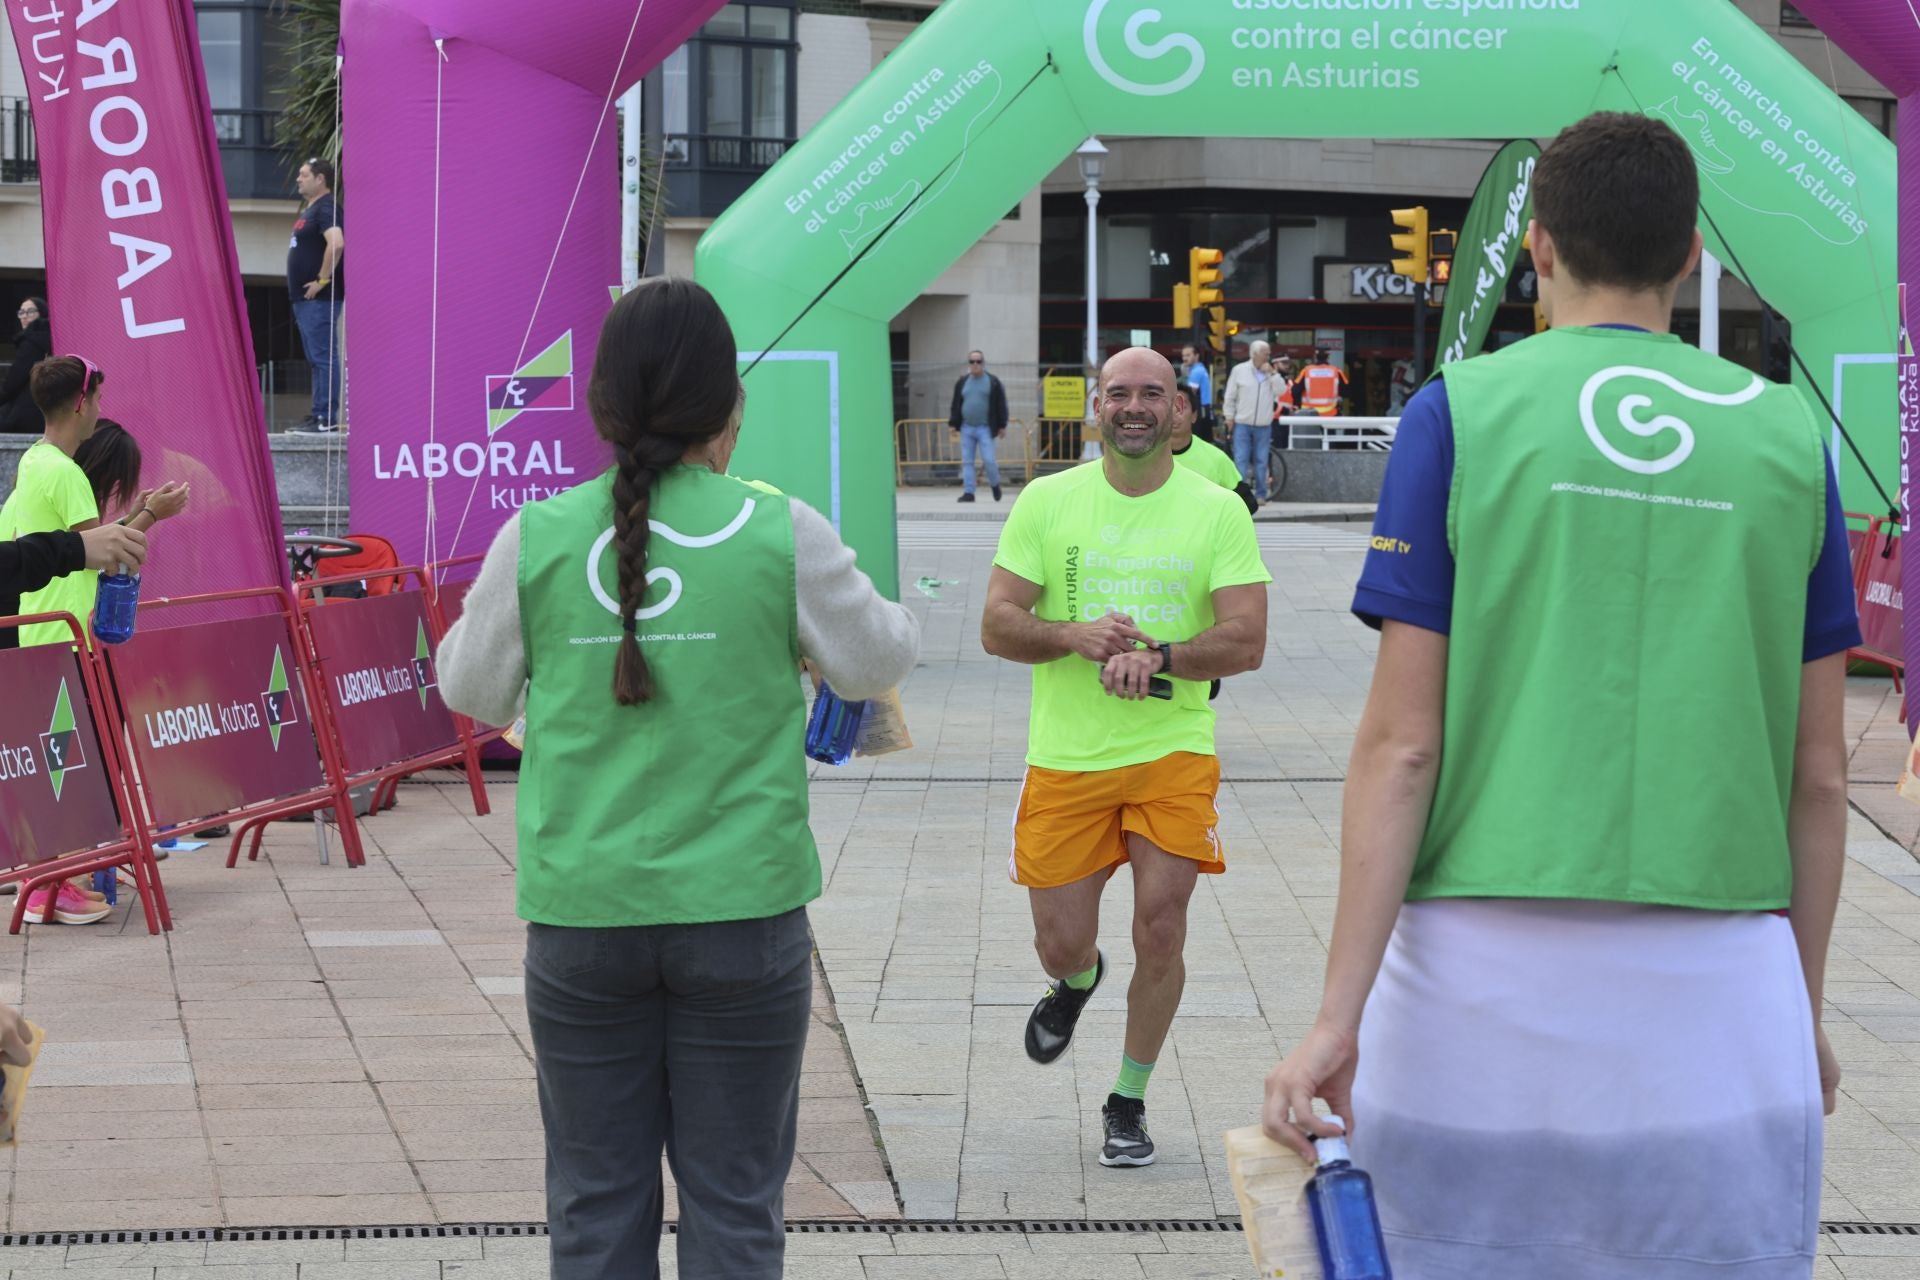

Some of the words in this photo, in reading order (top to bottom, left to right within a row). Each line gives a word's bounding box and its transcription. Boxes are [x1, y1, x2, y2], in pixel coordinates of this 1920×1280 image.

[1231, 21, 1341, 49] contra
[1351, 20, 1379, 50] el
[1389, 21, 1508, 50] cáncer
[1232, 66, 1273, 88] en
[1282, 61, 1420, 88] Asturias
[1691, 36, 1720, 67] En
[1719, 63, 1793, 132] marcha
[1793, 128, 1858, 188] contra
[784, 187, 814, 216] En
[812, 124, 884, 191] marcha
[882, 67, 945, 125] contra
[804, 210, 828, 235] el
[825, 152, 889, 216] cáncer
[889, 129, 917, 156] en
[914, 58, 994, 134] Asturias
[1671, 61, 1698, 84] el
[1693, 79, 1763, 141] cáncer
[1760, 138, 1789, 166] en
[1786, 162, 1869, 236] Asturias
[1908, 364, 1920, 433] kutxa
[373, 440, 576, 479] LABORAL
[1898, 363, 1911, 532] LABORAL
[1550, 482, 1602, 496] ASOCIACIÓN
[1603, 487, 1648, 501] ESPAÑOLA
[1649, 494, 1683, 506] CONTRA
[1684, 498, 1695, 508] EL
[1696, 499, 1734, 511] CÁNCER
[1084, 551, 1112, 568] En
[1116, 553, 1194, 573] marcha
[1083, 576, 1163, 595] contra
[1168, 576, 1188, 596] el
[647, 633, 676, 642] CONTRA
[677, 633, 686, 641] EL
[687, 631, 717, 641] CÁNCER
[335, 667, 387, 706] LABORAL
[382, 665, 413, 695] kutxa
[145, 703, 221, 749] LABORAL
[218, 700, 260, 734] kutxa
